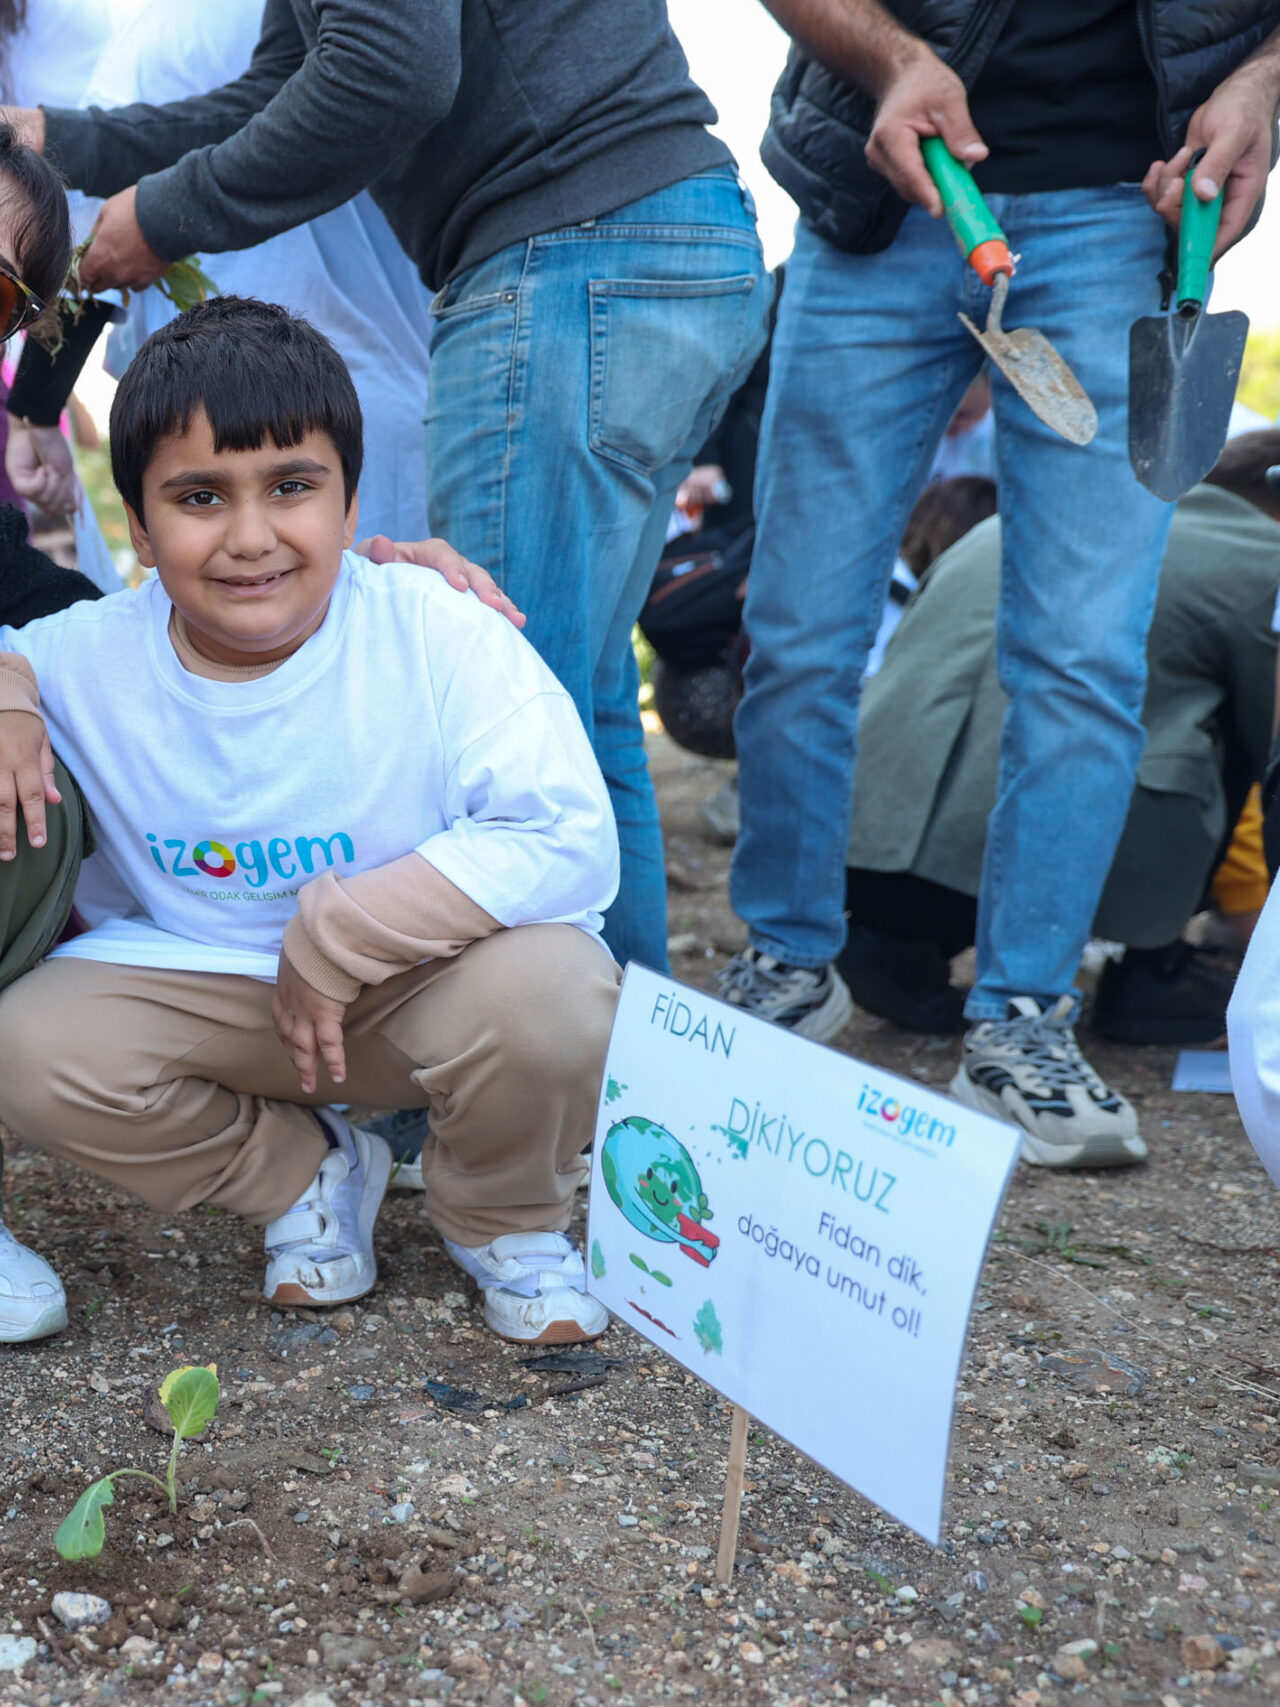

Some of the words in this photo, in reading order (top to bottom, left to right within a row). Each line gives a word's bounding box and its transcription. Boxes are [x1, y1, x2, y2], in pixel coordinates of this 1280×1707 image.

[146, 832, 355, 888] izogem
[209, 890, 240, 901] ODAK
[650, 992, 736, 1059] FİDAN
[857, 1083, 956, 1147] izogem
[728, 1097, 897, 1214] DİKİYORUZ
[738, 1214, 820, 1277] doğaya
[827, 1266, 886, 1315] umut
[892, 1306, 921, 1338] ol!
[818, 1211, 881, 1267] Fidan
[887, 1255, 926, 1295] dik,
